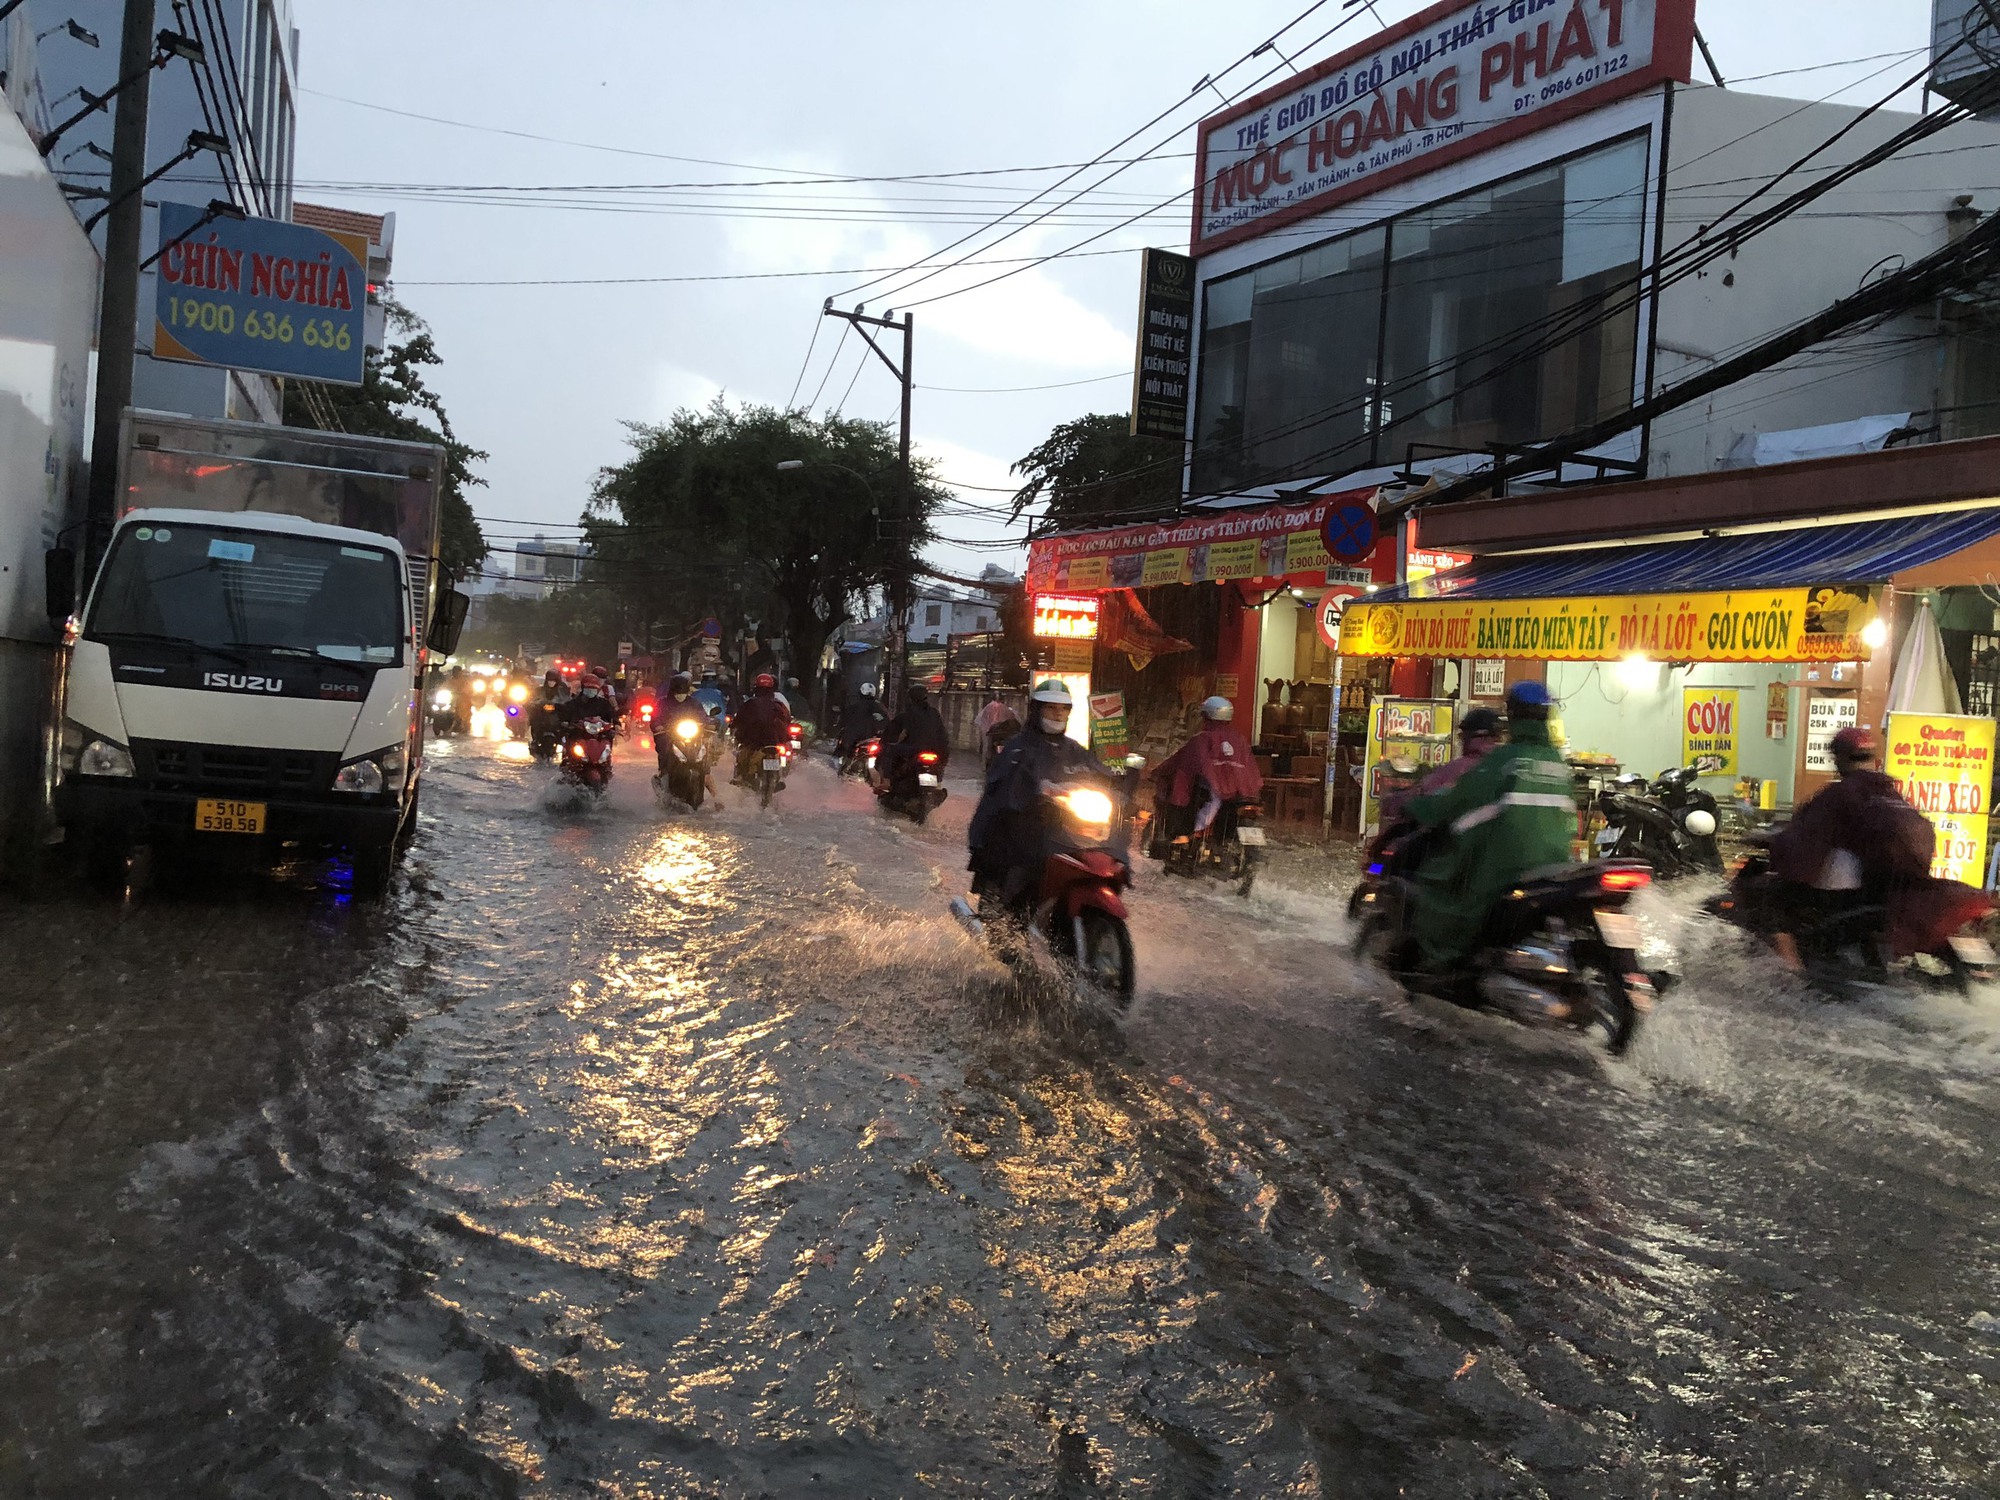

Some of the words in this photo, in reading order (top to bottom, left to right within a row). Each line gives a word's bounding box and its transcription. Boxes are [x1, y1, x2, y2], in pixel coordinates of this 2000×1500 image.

[1237, 106, 1272, 150] THẾ
[1277, 91, 1315, 133] GIỚI
[1320, 72, 1348, 112] ĐỒ
[1354, 56, 1383, 96] GỖ
[1390, 39, 1435, 80] NỘI
[1438, 5, 1499, 56] THẤT
[1541, 77, 1573, 101] 0986
[1575, 65, 1601, 86] 601
[1604, 53, 1629, 76] 122
[1211, 140, 1295, 212] MỘC
[1308, 65, 1458, 173] HOÀNG
[1479, 0, 1623, 102] PHÁT
[1298, 179, 1315, 196] TÂN
[1317, 162, 1350, 191] THÀNH
[1356, 160, 1368, 173] Q.
[1370, 151, 1389, 168] TÂN
[1390, 138, 1413, 162] PHÚ
[160, 231, 243, 292] CHÍN
[251, 251, 353, 311] NGHĨA
[169, 296, 235, 336] 1900
[243, 309, 294, 343] 636
[302, 317, 351, 351] 636
[1408, 551, 1434, 565] BÁNH
[1435, 553, 1454, 567] XÈO
[1403, 609, 1427, 649] BÚN
[1427, 609, 1446, 649] BÒ
[1446, 607, 1471, 648] HUẾ
[1477, 608, 1512, 649] BÁNH
[1512, 607, 1540, 649] XÈO
[1579, 604, 1609, 650] TÂY
[1618, 603, 1638, 650] BÒ
[1641, 603, 1661, 650] LÁ
[1664, 601, 1697, 650] LỐT
[1707, 595, 1740, 650] GỎI
[1742, 598, 1793, 650] CUỐN
[203, 672, 283, 692] ISUZU
[320, 683, 359, 693] QKR
[1687, 695, 1732, 735] CƠM
[1811, 702, 1835, 716] BÚN
[1840, 702, 1855, 717] BÒ
[1810, 719, 1827, 728] 25K
[1920, 724, 1966, 741] Quán
[1689, 736, 1712, 751] BÌNH
[1913, 741, 1940, 757] TÂN
[1943, 743, 1988, 761] THÀNH
[1807, 755, 1826, 765] 20K
[216, 802, 246, 817] 51D
[203, 816, 257, 832] 538.58
